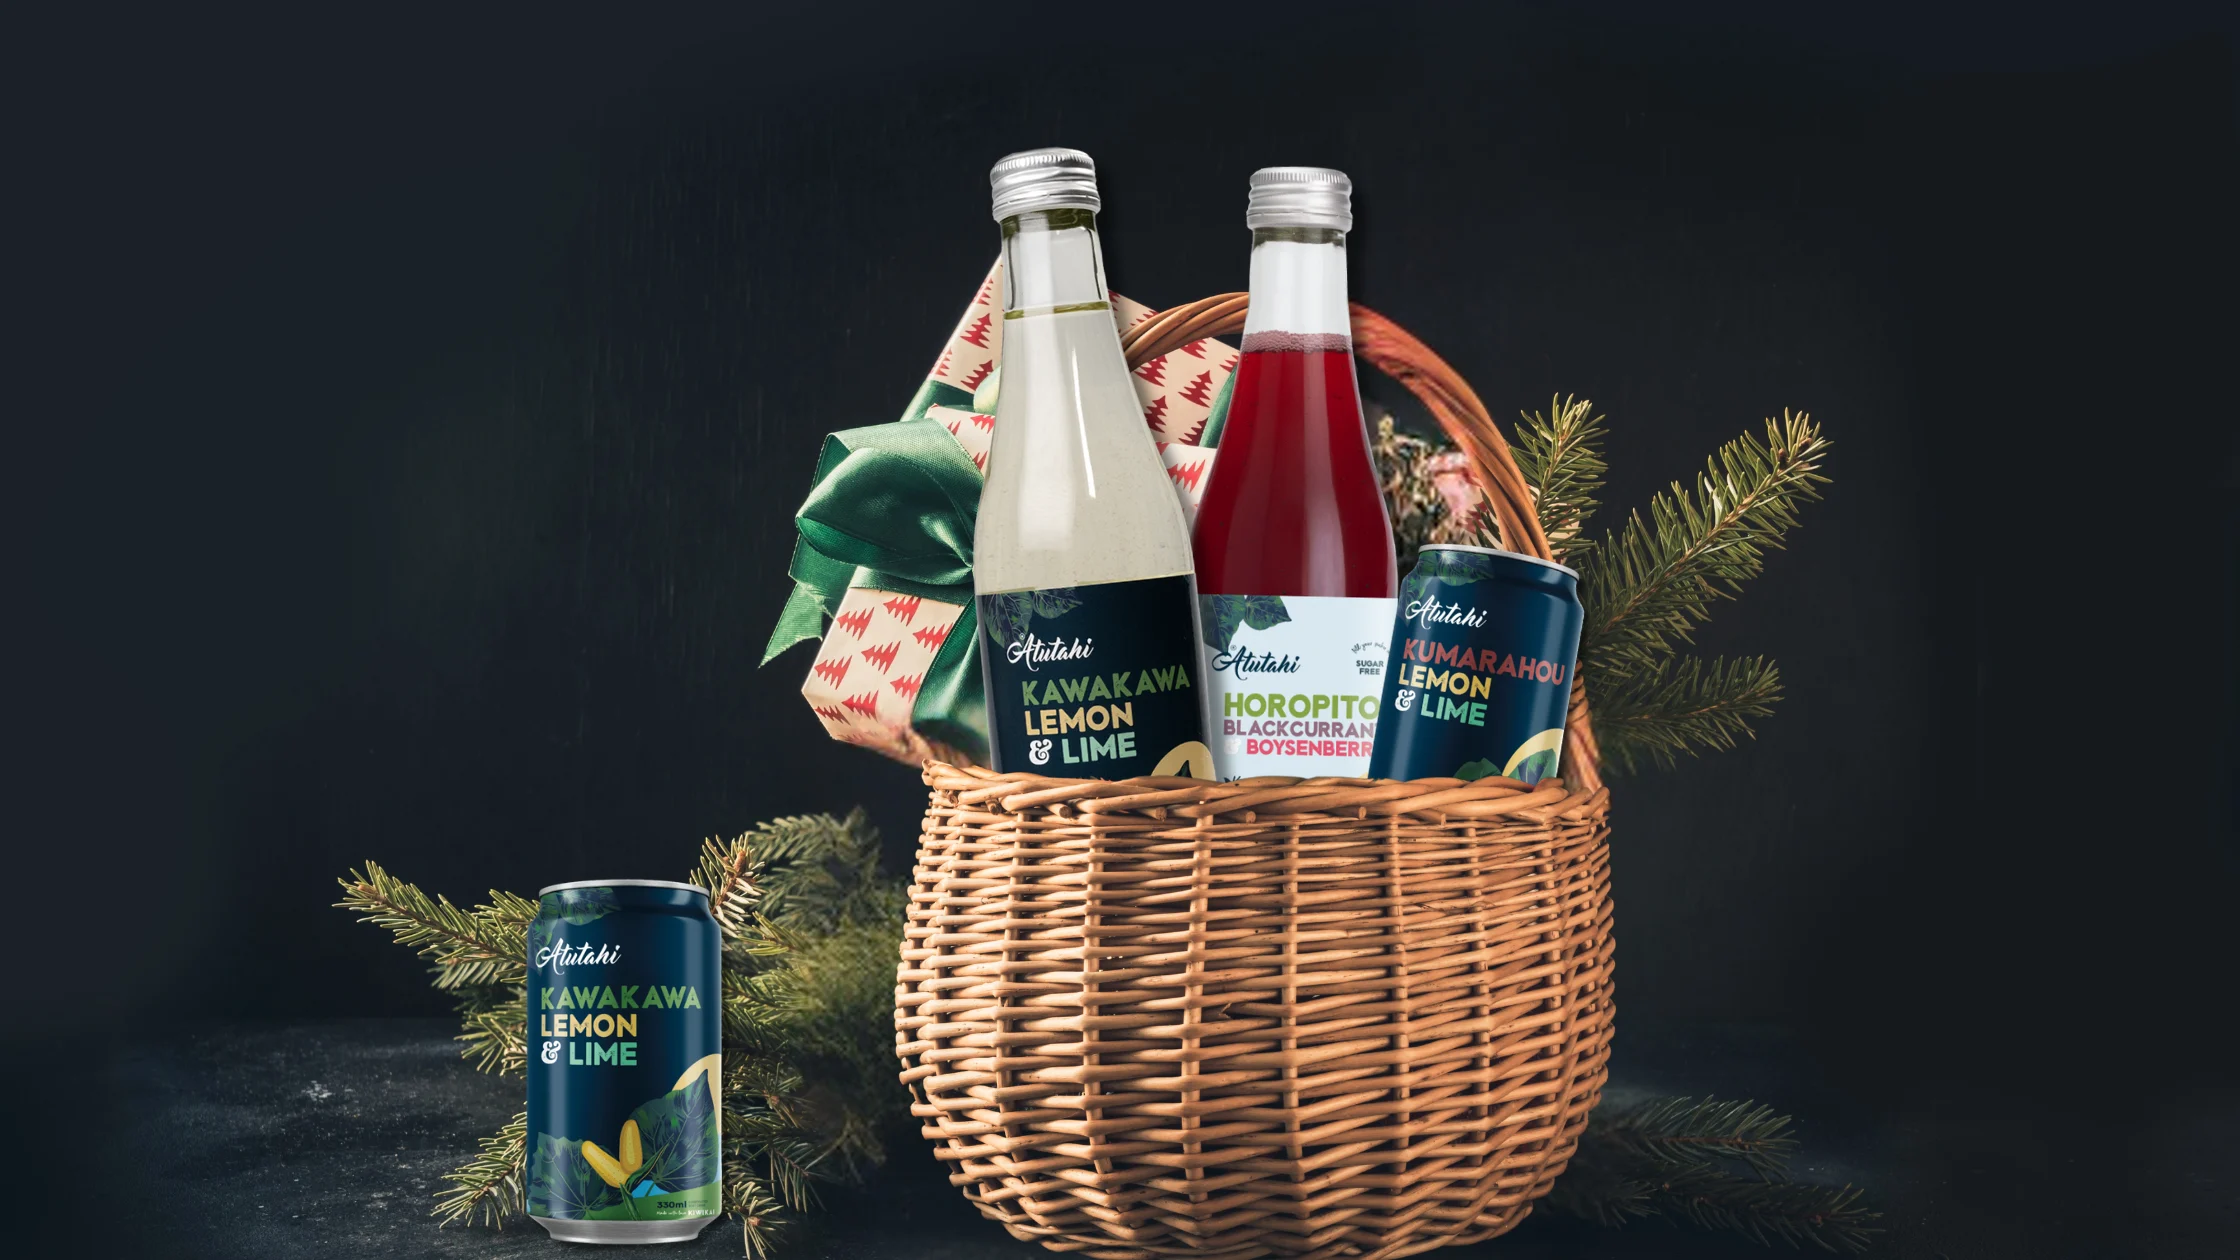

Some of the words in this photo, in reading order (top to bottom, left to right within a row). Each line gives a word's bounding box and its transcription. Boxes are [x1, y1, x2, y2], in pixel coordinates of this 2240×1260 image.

[1405, 595, 1488, 630] Atutahi
[1007, 633, 1094, 671] Atutahi
[1212, 646, 1301, 680] Atutahi
[1403, 638, 1565, 686] KUMARAHOU
[1022, 664, 1190, 706] KAWAKAWA
[1398, 663, 1492, 699] LEMON
[1025, 702, 1134, 736] LEMON
[1224, 693, 1380, 719] HOROPITO
[1395, 690, 1416, 712] &
[1421, 694, 1488, 727] LIME
[1223, 719, 1377, 738] BLACKCURRAN
[1029, 739, 1052, 765] &
[1062, 732, 1137, 764] LIME
[1246, 739, 1373, 757] BOYSENBERR
[535, 938, 622, 975] Atutahi
[541, 985, 701, 1010] KAWAKAWA
[541, 1014, 637, 1037] LEMON
[541, 1041, 562, 1065] &
[569, 1042, 637, 1066] LIME
[656, 1201, 687, 1209] 330ml
